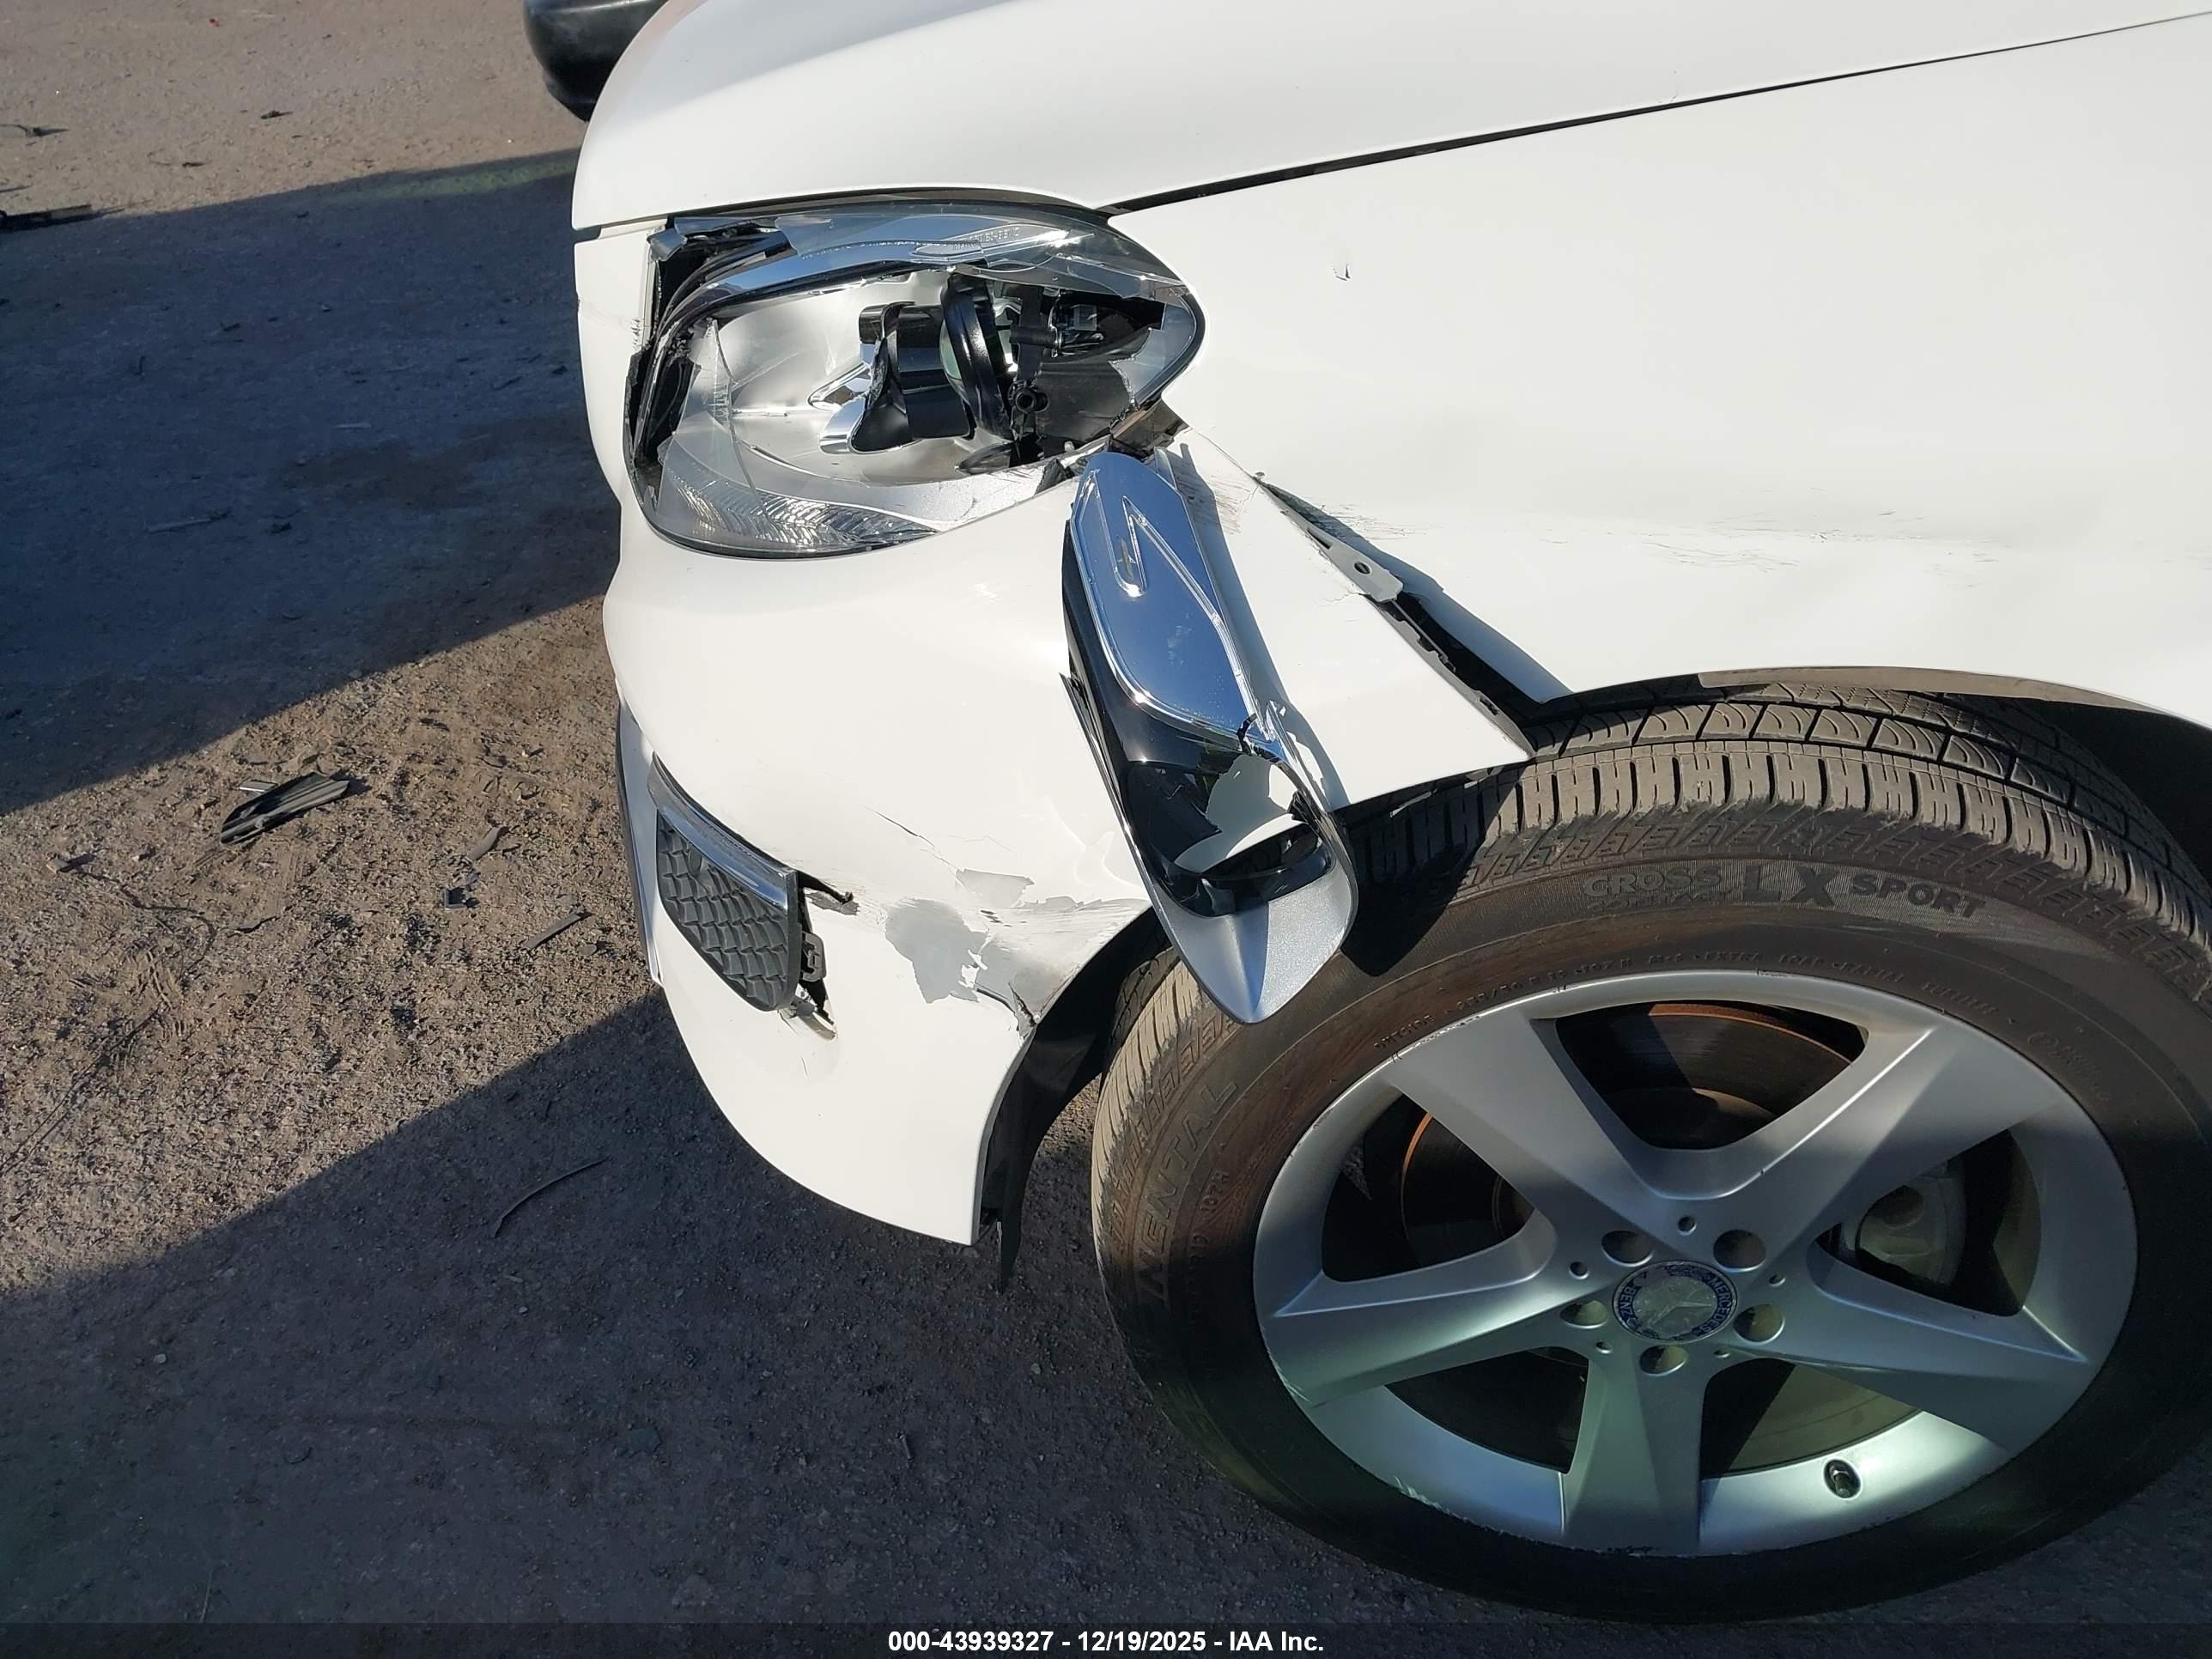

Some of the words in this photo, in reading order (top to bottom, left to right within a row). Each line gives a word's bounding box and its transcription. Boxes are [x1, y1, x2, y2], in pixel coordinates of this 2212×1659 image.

[1583, 864, 1723, 896] CROSS
[1849, 872, 1987, 917] SPORT
[1620, 1285, 1637, 1317] BENZ
[1699, 1279, 1732, 1333] MERCEDES
